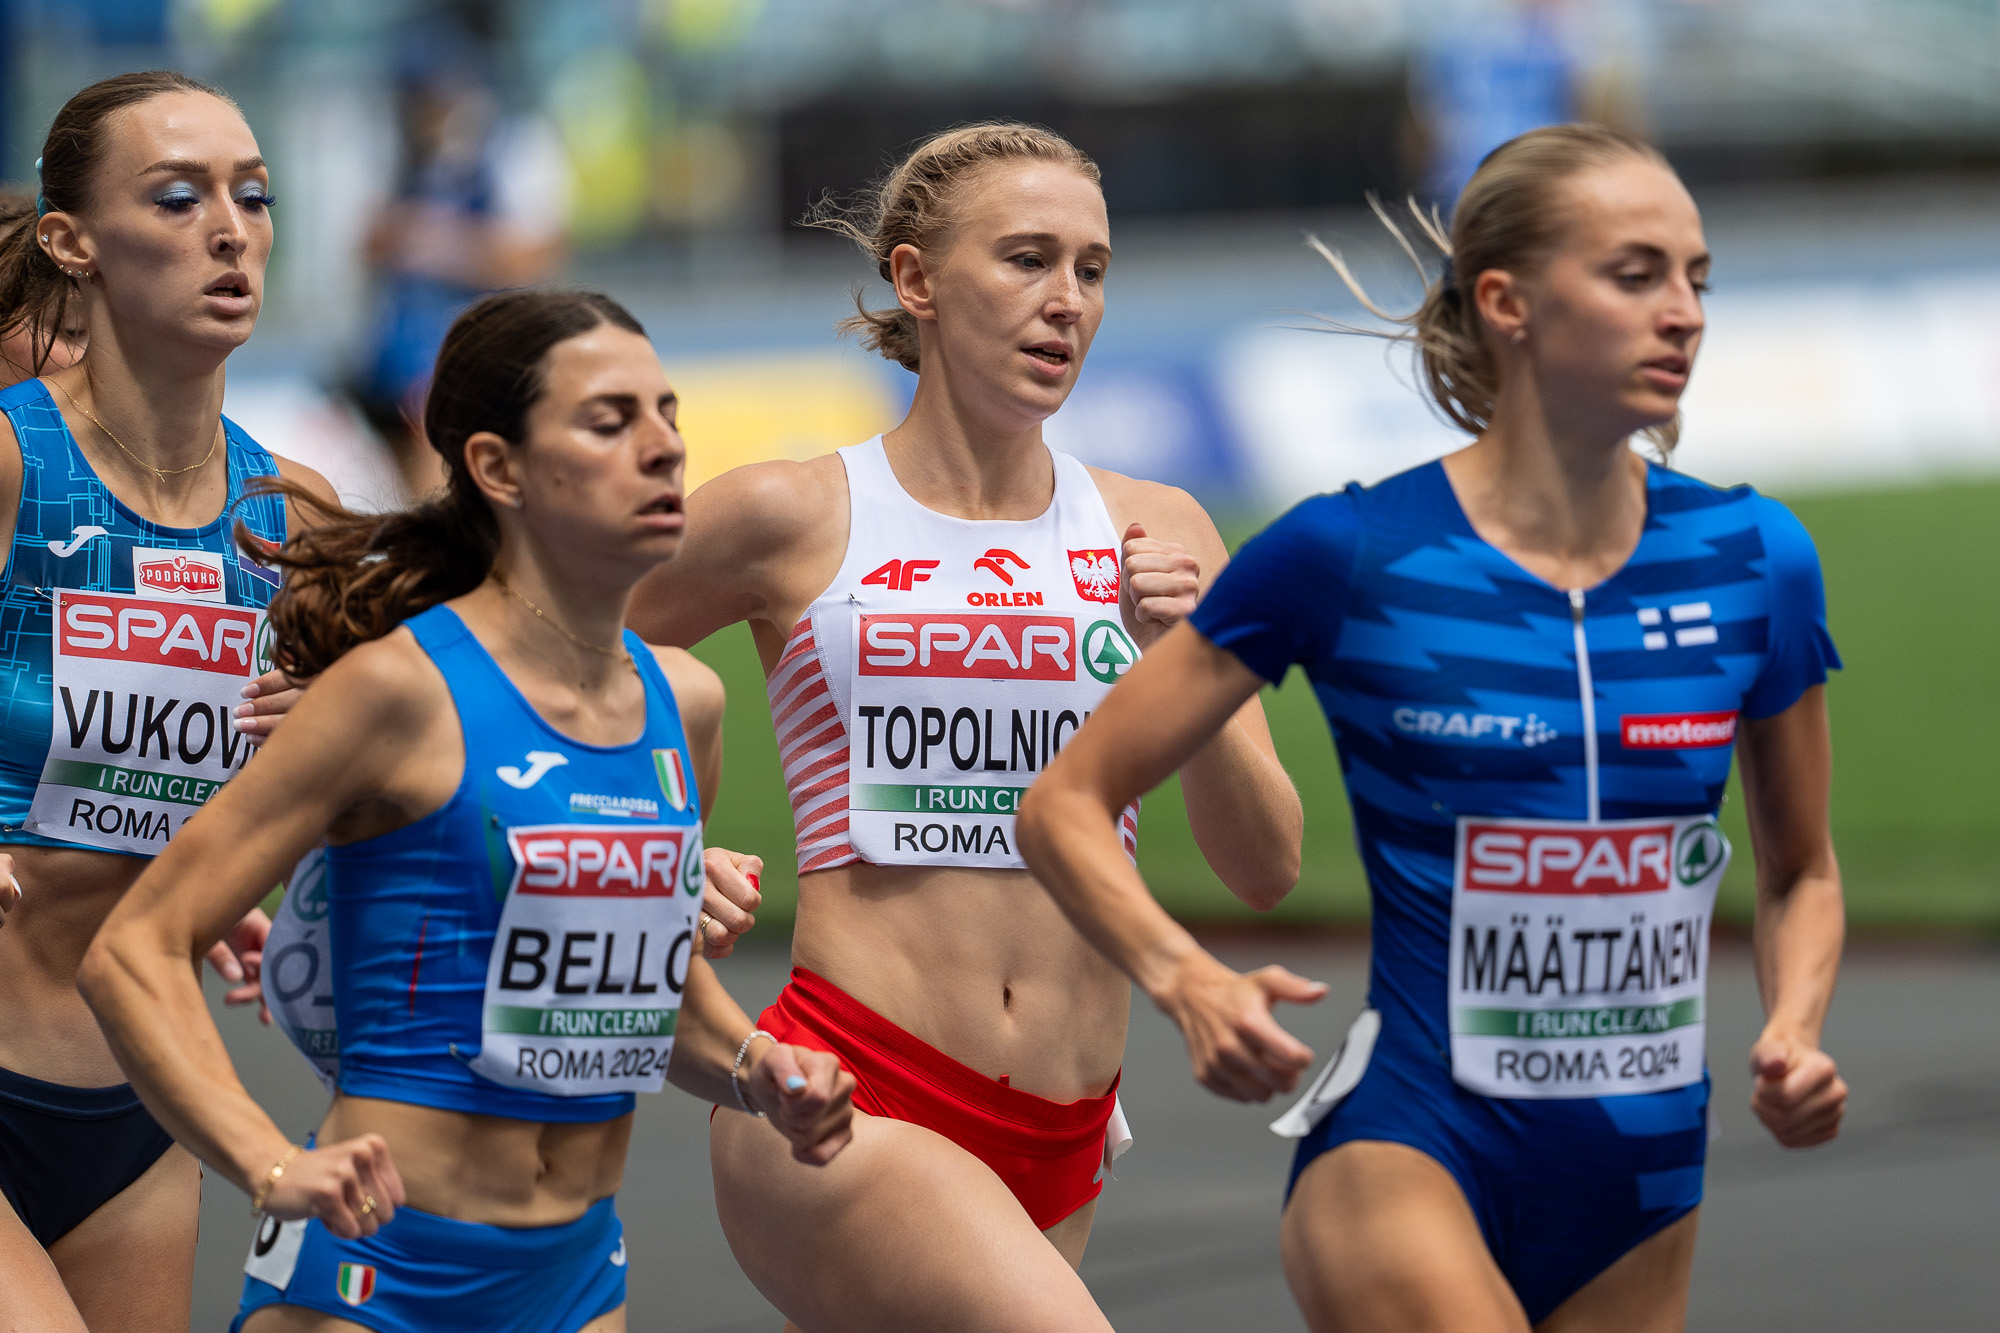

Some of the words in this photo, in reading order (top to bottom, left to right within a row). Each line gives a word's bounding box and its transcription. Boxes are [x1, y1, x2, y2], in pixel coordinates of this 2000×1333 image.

[146, 567, 217, 585] PODRAVKA
[966, 591, 1044, 606] ORLEN
[66, 603, 251, 667] SPAR
[866, 622, 1070, 671] SPAR
[59, 686, 258, 771] VUKOV
[858, 705, 1091, 772] TOPOLNIC
[1393, 707, 1521, 740] CRAFT
[99, 768, 107, 788] I
[111, 770, 164, 797] RUN
[915, 788, 921, 809] I
[928, 788, 986, 810] RUN
[68, 798, 171, 843] ROMA
[894, 823, 1011, 855] ROMA
[525, 839, 678, 889] SPAR
[1470, 833, 1669, 887] SPAR
[1462, 913, 1702, 995] MÄÄTTÄNEN
[539, 1010, 549, 1033] I
[551, 1010, 598, 1035] RUN
[1517, 1012, 1528, 1035] I
[1531, 1010, 1591, 1036] RUN
[516, 1047, 605, 1079] ROMA
[608, 1046, 669, 1078] 2024
[1496, 1049, 1611, 1082] ROMA
[1617, 1041, 1681, 1079] 2024
